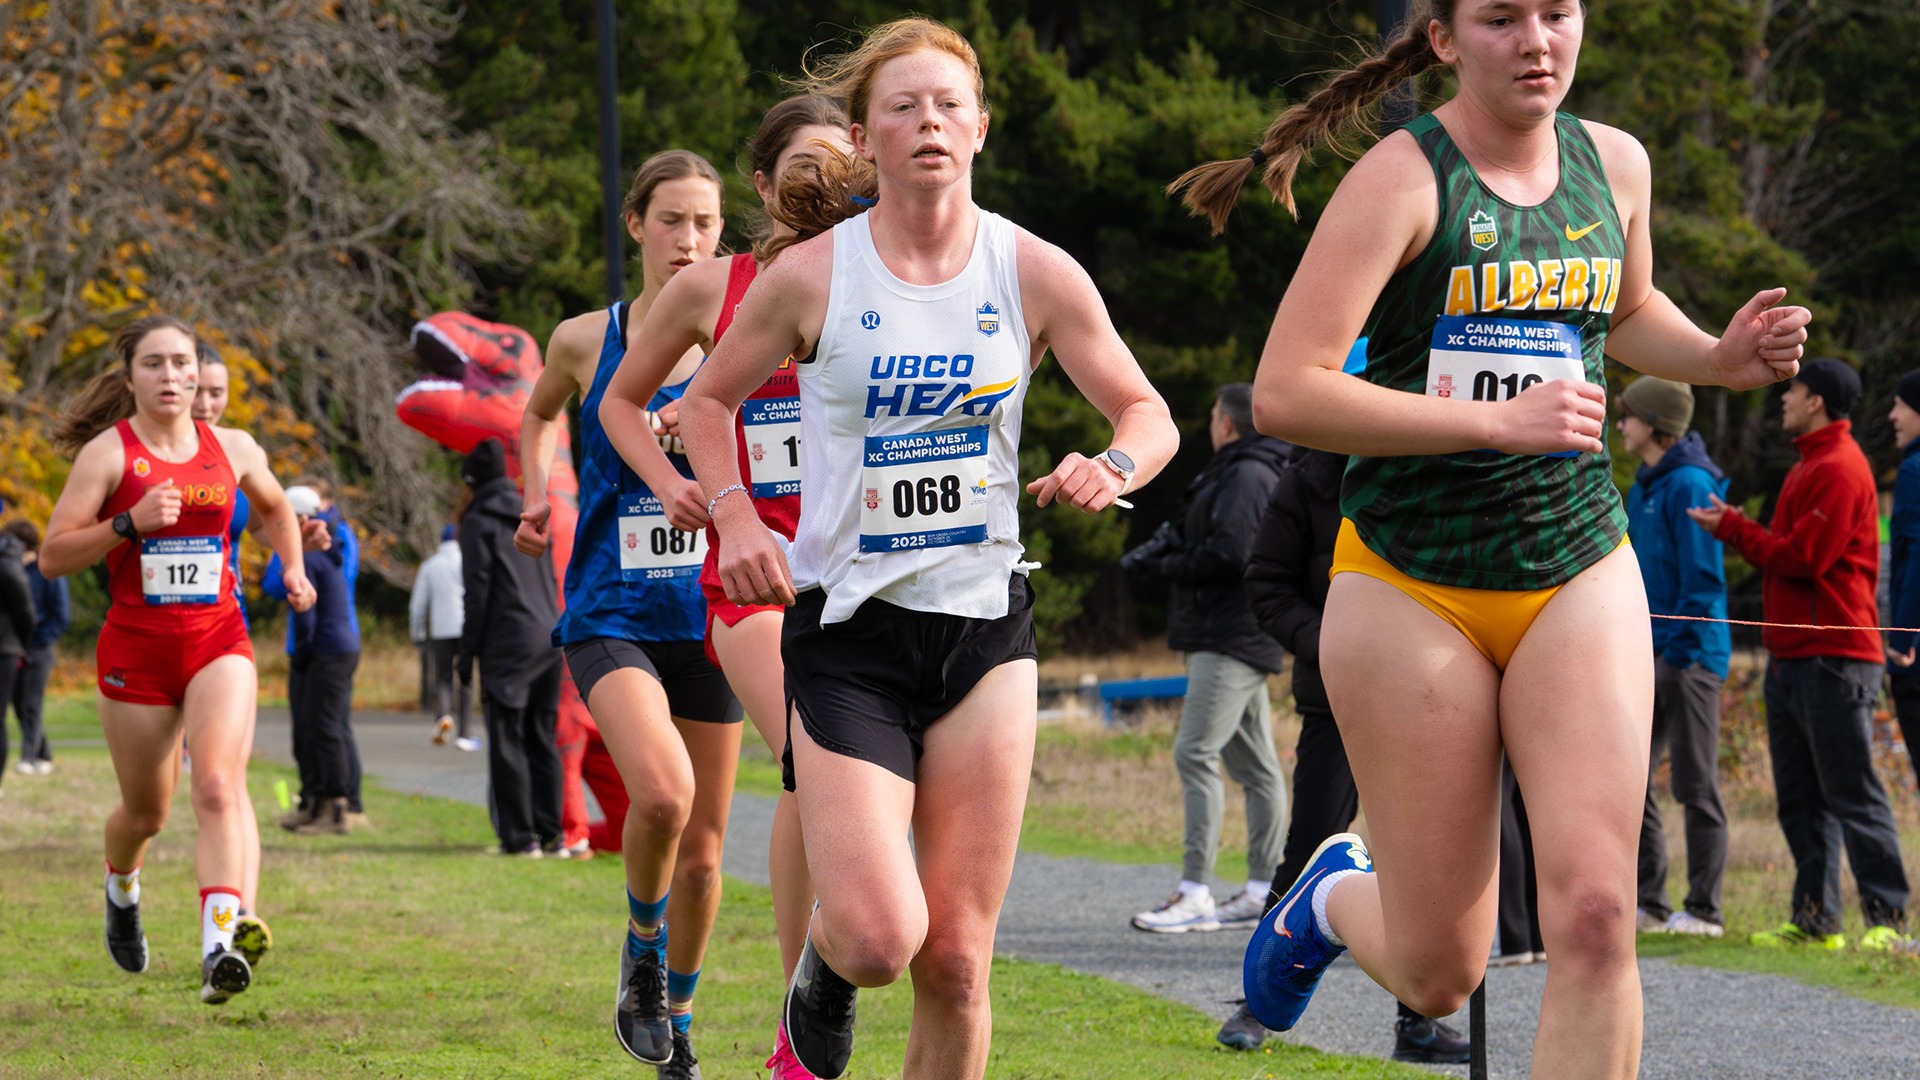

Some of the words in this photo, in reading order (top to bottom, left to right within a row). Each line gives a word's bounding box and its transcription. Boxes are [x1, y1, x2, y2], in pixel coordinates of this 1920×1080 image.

[1473, 232, 1495, 244] WEST
[1444, 257, 1621, 316] ALBERTA
[980, 321, 997, 331] WEST
[1465, 323, 1519, 336] CANADA
[1523, 327, 1559, 339] WEST
[1447, 335, 1465, 345] XC
[1468, 335, 1572, 353] CHAMPIONSHIPS
[870, 354, 974, 379] UBCO
[864, 375, 1020, 418] HEAT
[753, 412, 766, 421] XC
[768, 409, 801, 419] CHAM
[882, 437, 932, 450] CANADA
[935, 433, 967, 444] WEST
[783, 435, 801, 467] 1
[868, 453, 884, 462] XC
[887, 442, 981, 460] CHAMPIONSHIPS
[893, 475, 961, 518] 068
[628, 505, 641, 514] XC
[651, 527, 697, 556] 087
[891, 535, 926, 548] 2025
[166, 563, 198, 585] 112
[647, 569, 675, 579] 2025
